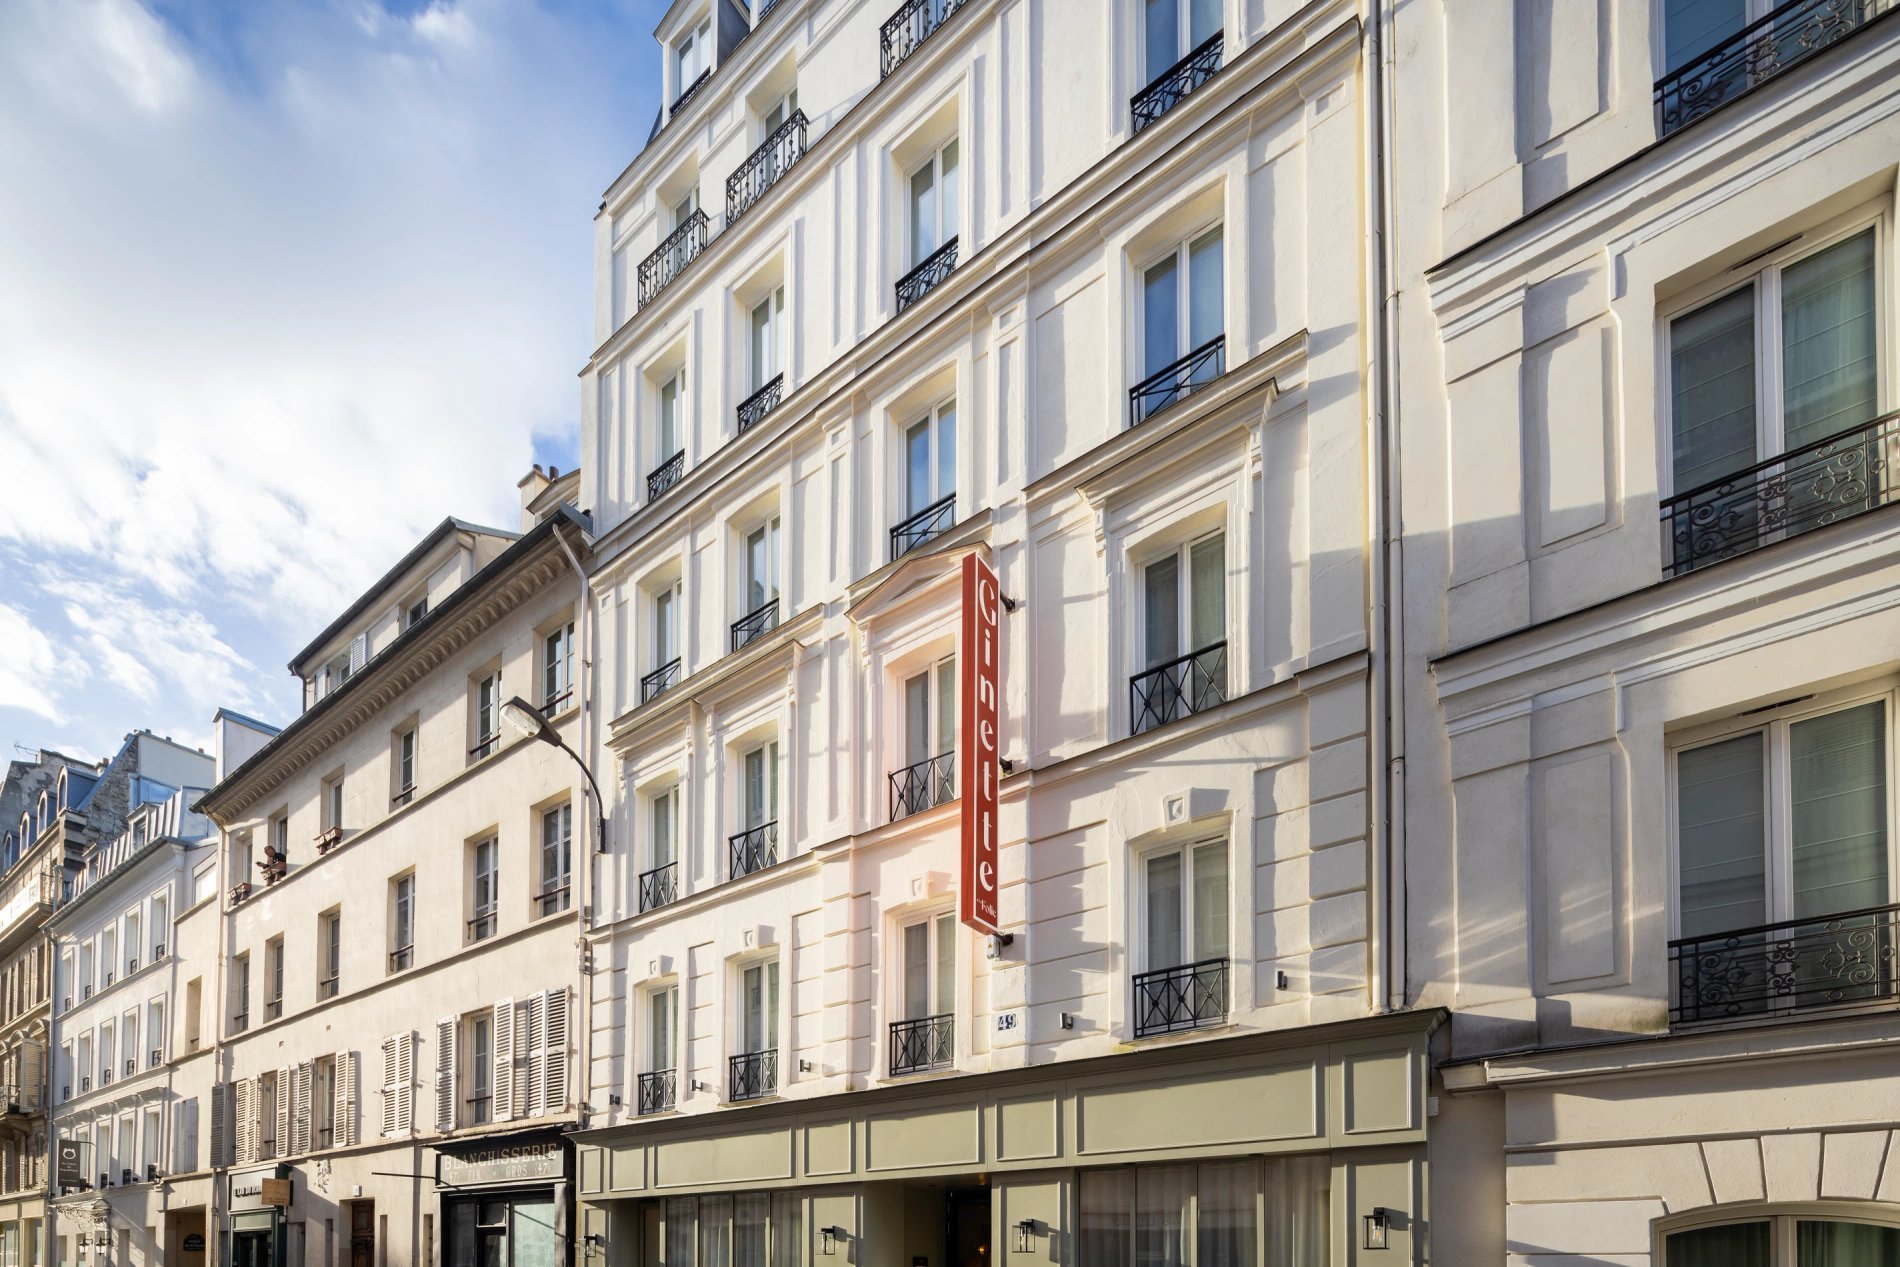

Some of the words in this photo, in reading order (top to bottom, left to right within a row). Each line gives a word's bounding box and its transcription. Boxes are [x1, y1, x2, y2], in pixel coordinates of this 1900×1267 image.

[979, 579, 996, 892] Ginette
[999, 1014, 1016, 1030] 49
[444, 1144, 557, 1170] BLANCHISSERIE
[506, 1164, 528, 1178] GROS
